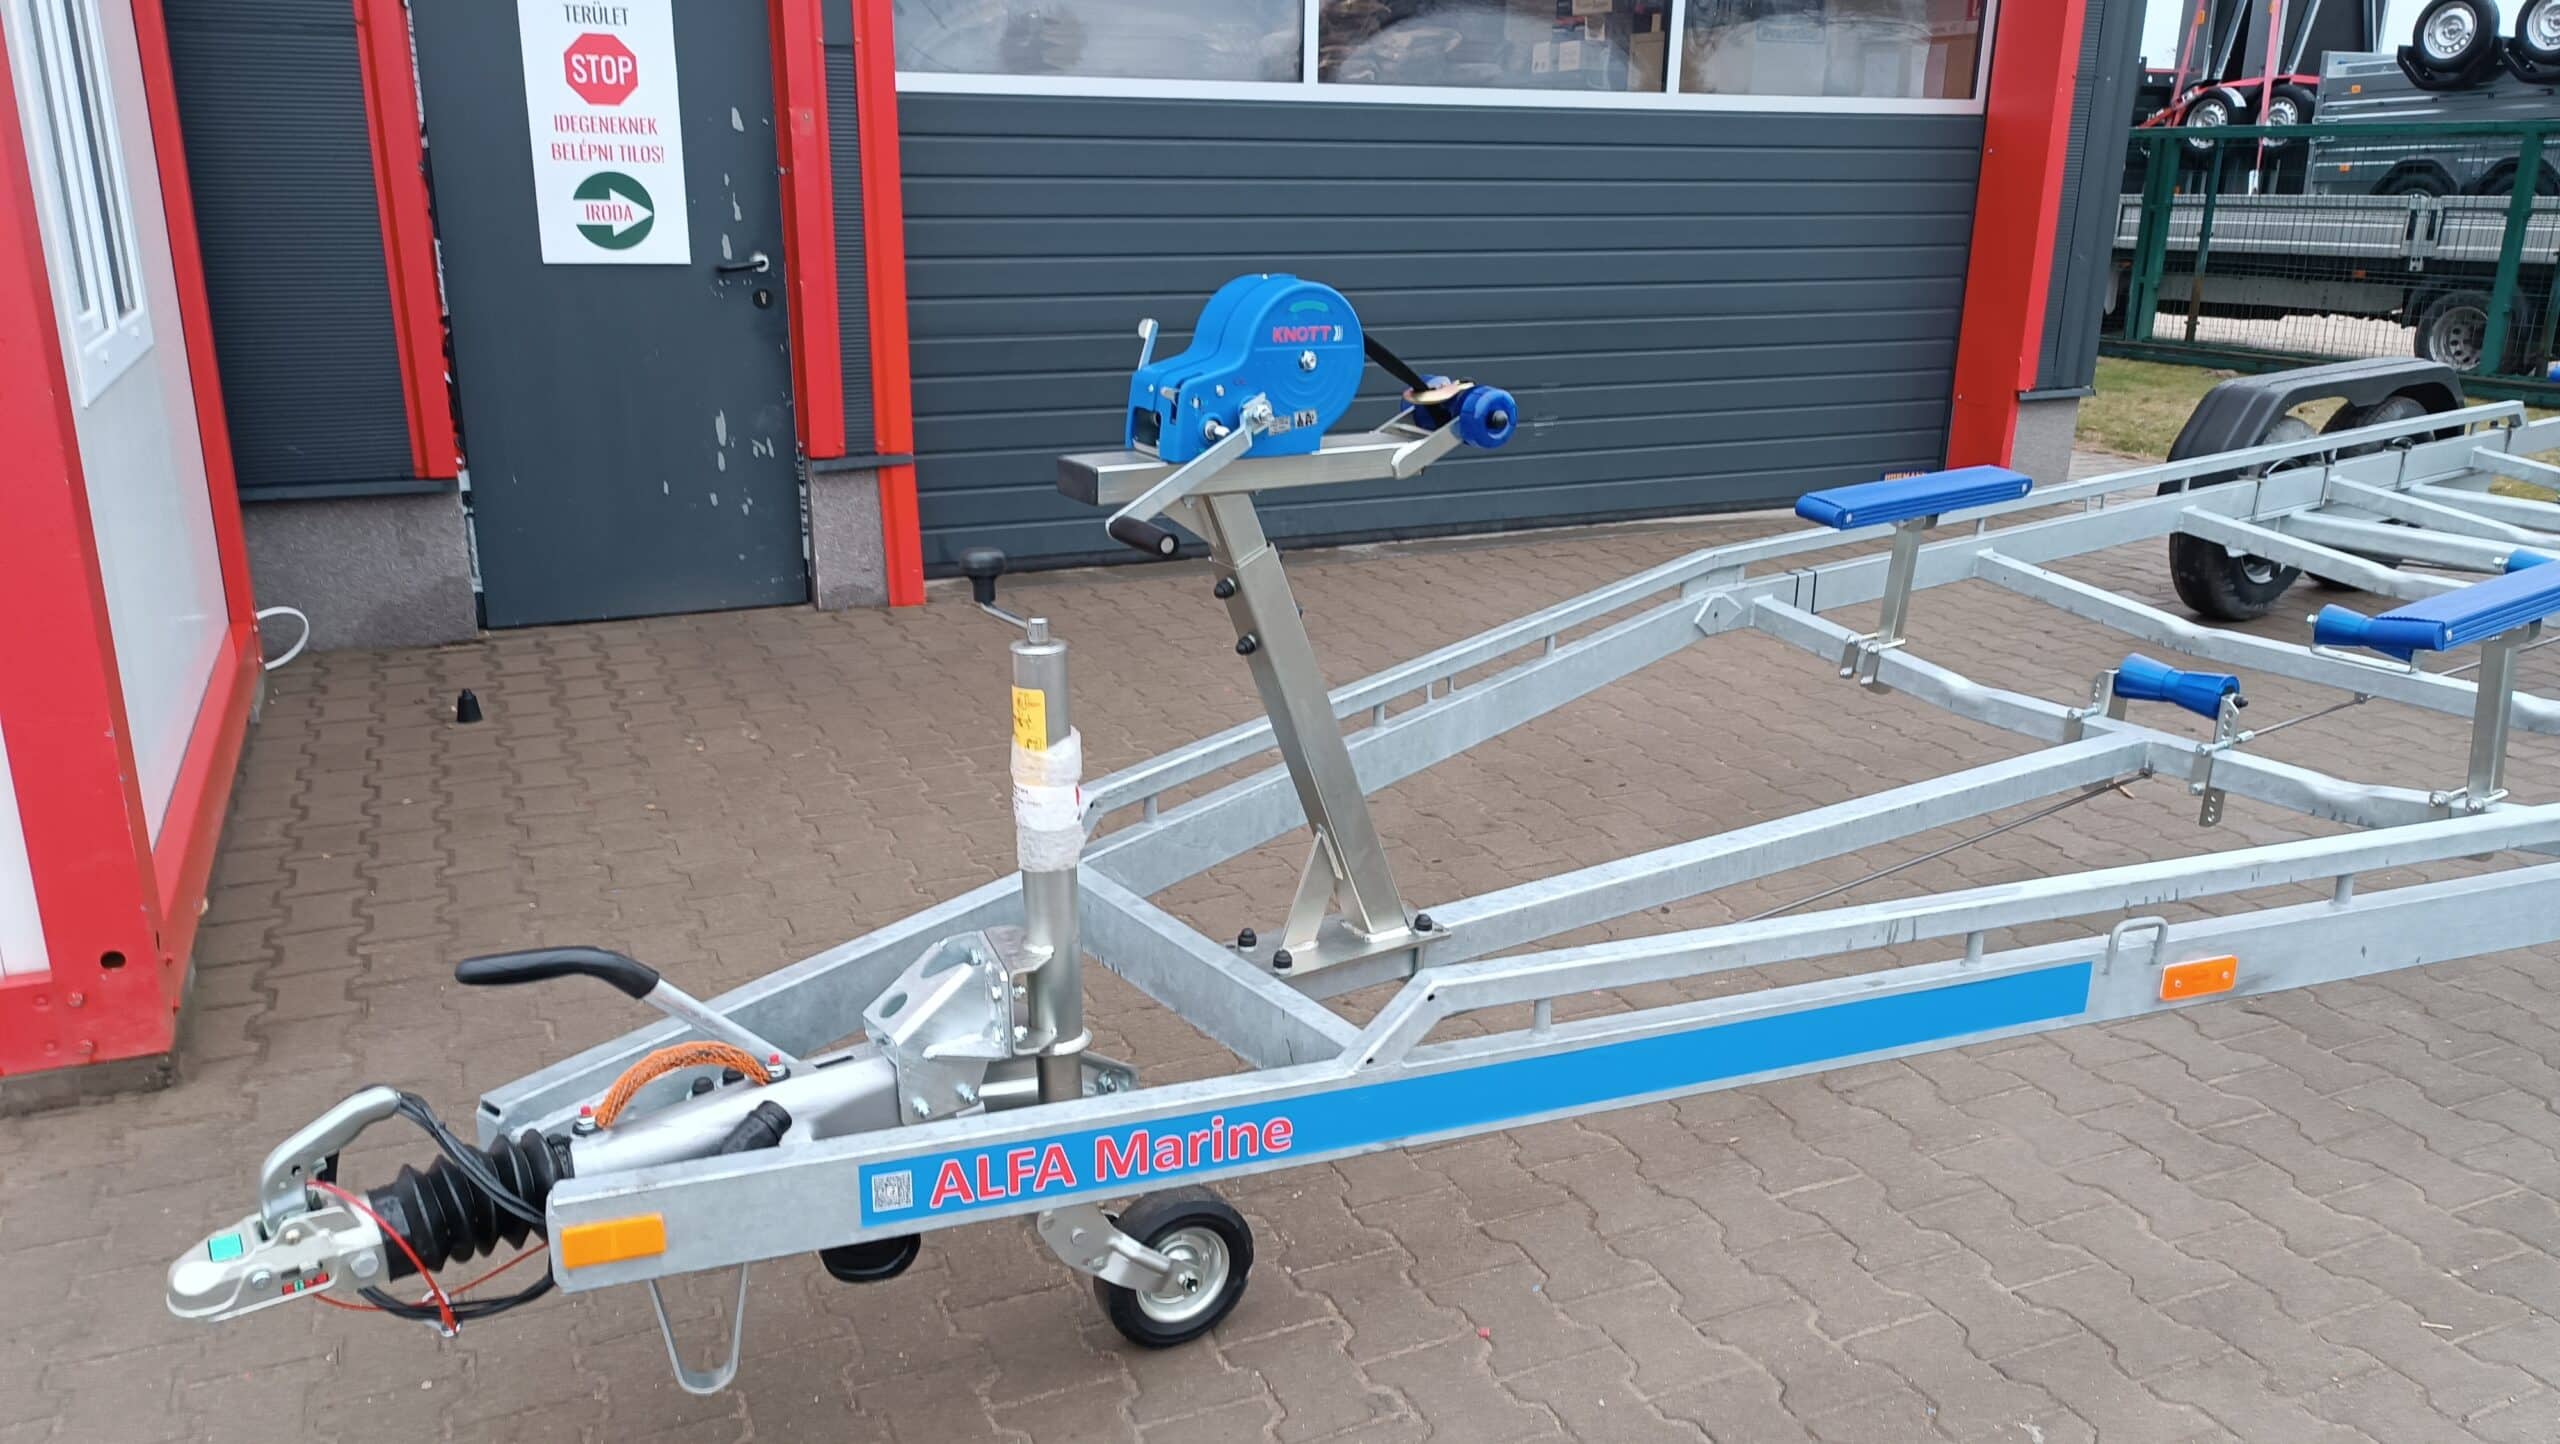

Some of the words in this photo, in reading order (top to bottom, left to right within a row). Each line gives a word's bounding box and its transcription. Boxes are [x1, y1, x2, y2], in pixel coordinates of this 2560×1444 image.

[563, 1, 629, 26] TERÜLET
[571, 54, 633, 86] STOP
[554, 114, 658, 135] IDEGENEKNEK
[551, 138, 614, 163] BELÉPNI
[620, 144, 665, 164] TILOS!
[585, 203, 634, 222] IRODA
[1272, 325, 1332, 343] KNOTT
[930, 1145, 1077, 1209] ALFA
[1094, 1115, 1294, 1183] Marine
